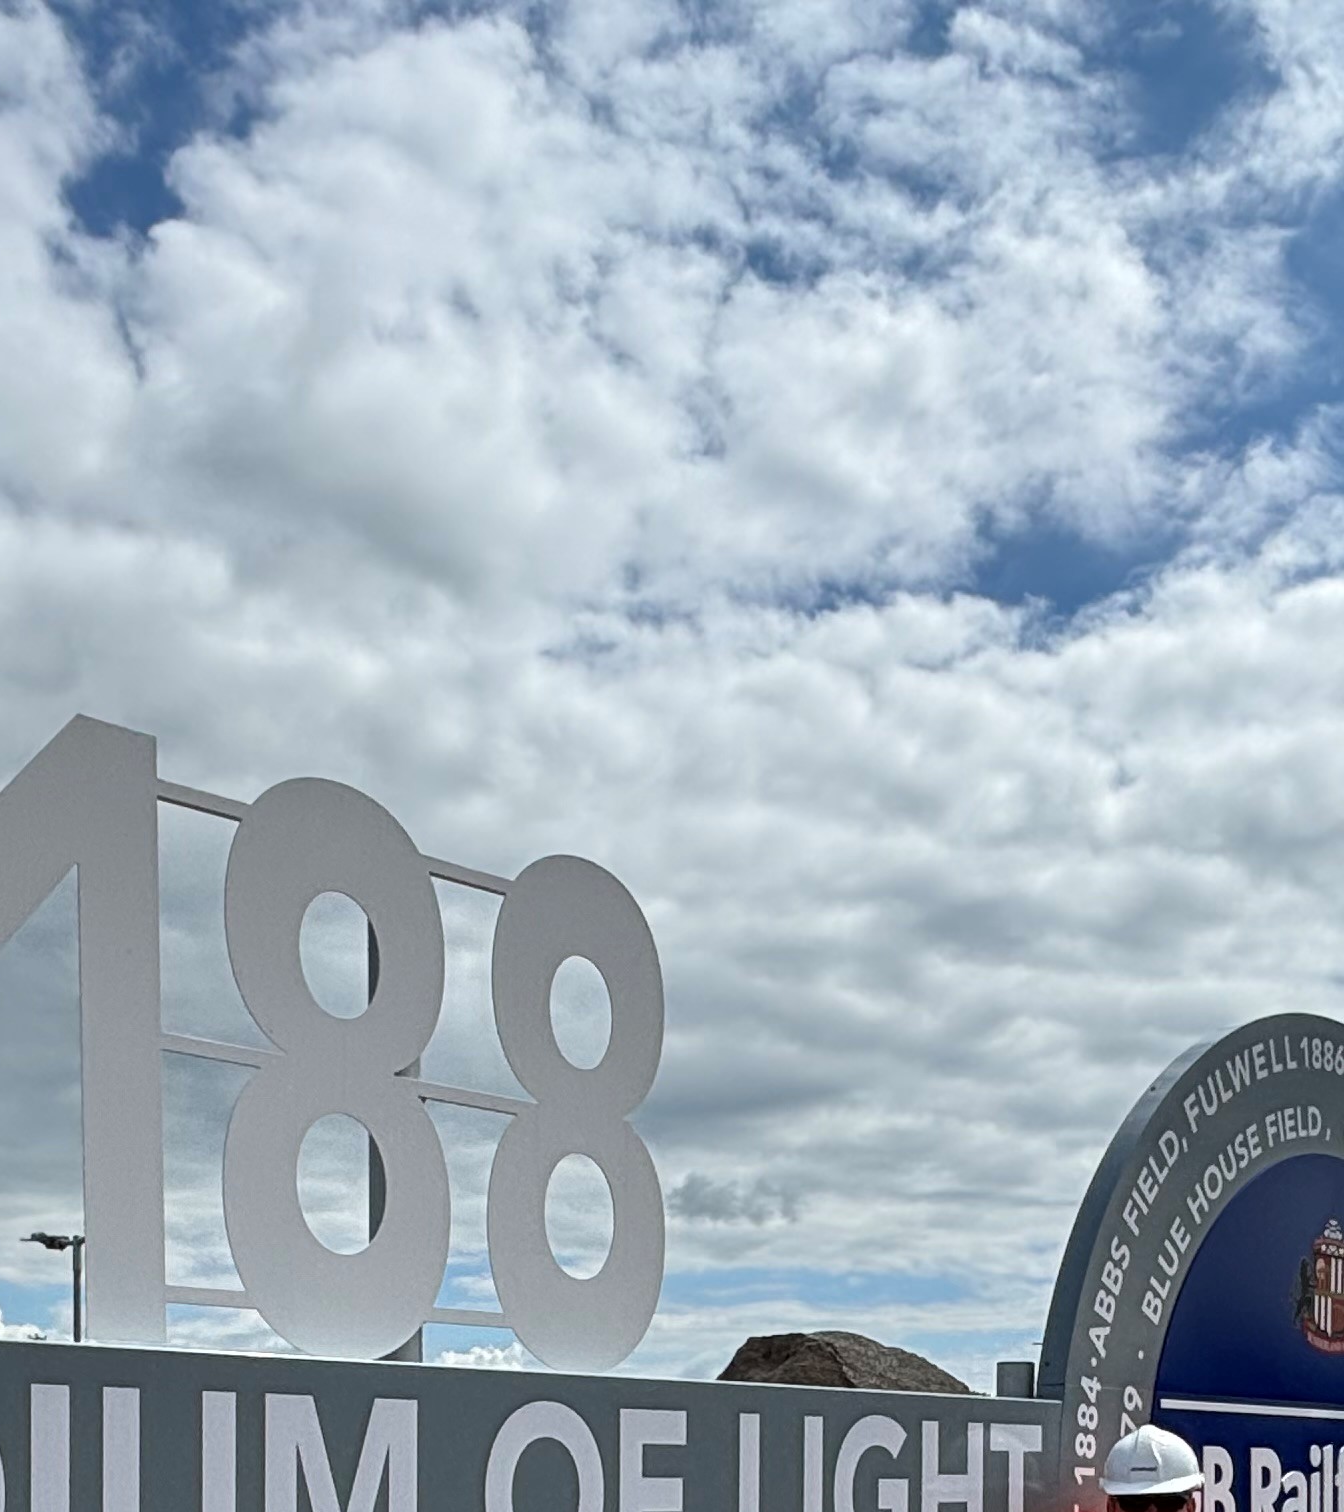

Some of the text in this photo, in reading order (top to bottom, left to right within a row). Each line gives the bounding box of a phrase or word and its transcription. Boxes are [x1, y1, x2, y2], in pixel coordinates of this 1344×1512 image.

[1074, 1376, 1102, 1485] 1884
[1088, 1236, 1131, 1359] ABBS
[1122, 1130, 1189, 1237] FIELD,
[1183, 1035, 1298, 1134] FULWELL
[1141, 1215, 1192, 1326] BLUE
[1186, 1123, 1263, 1225] HOUSE
[1264, 1105, 1331, 1148] FIELD,
